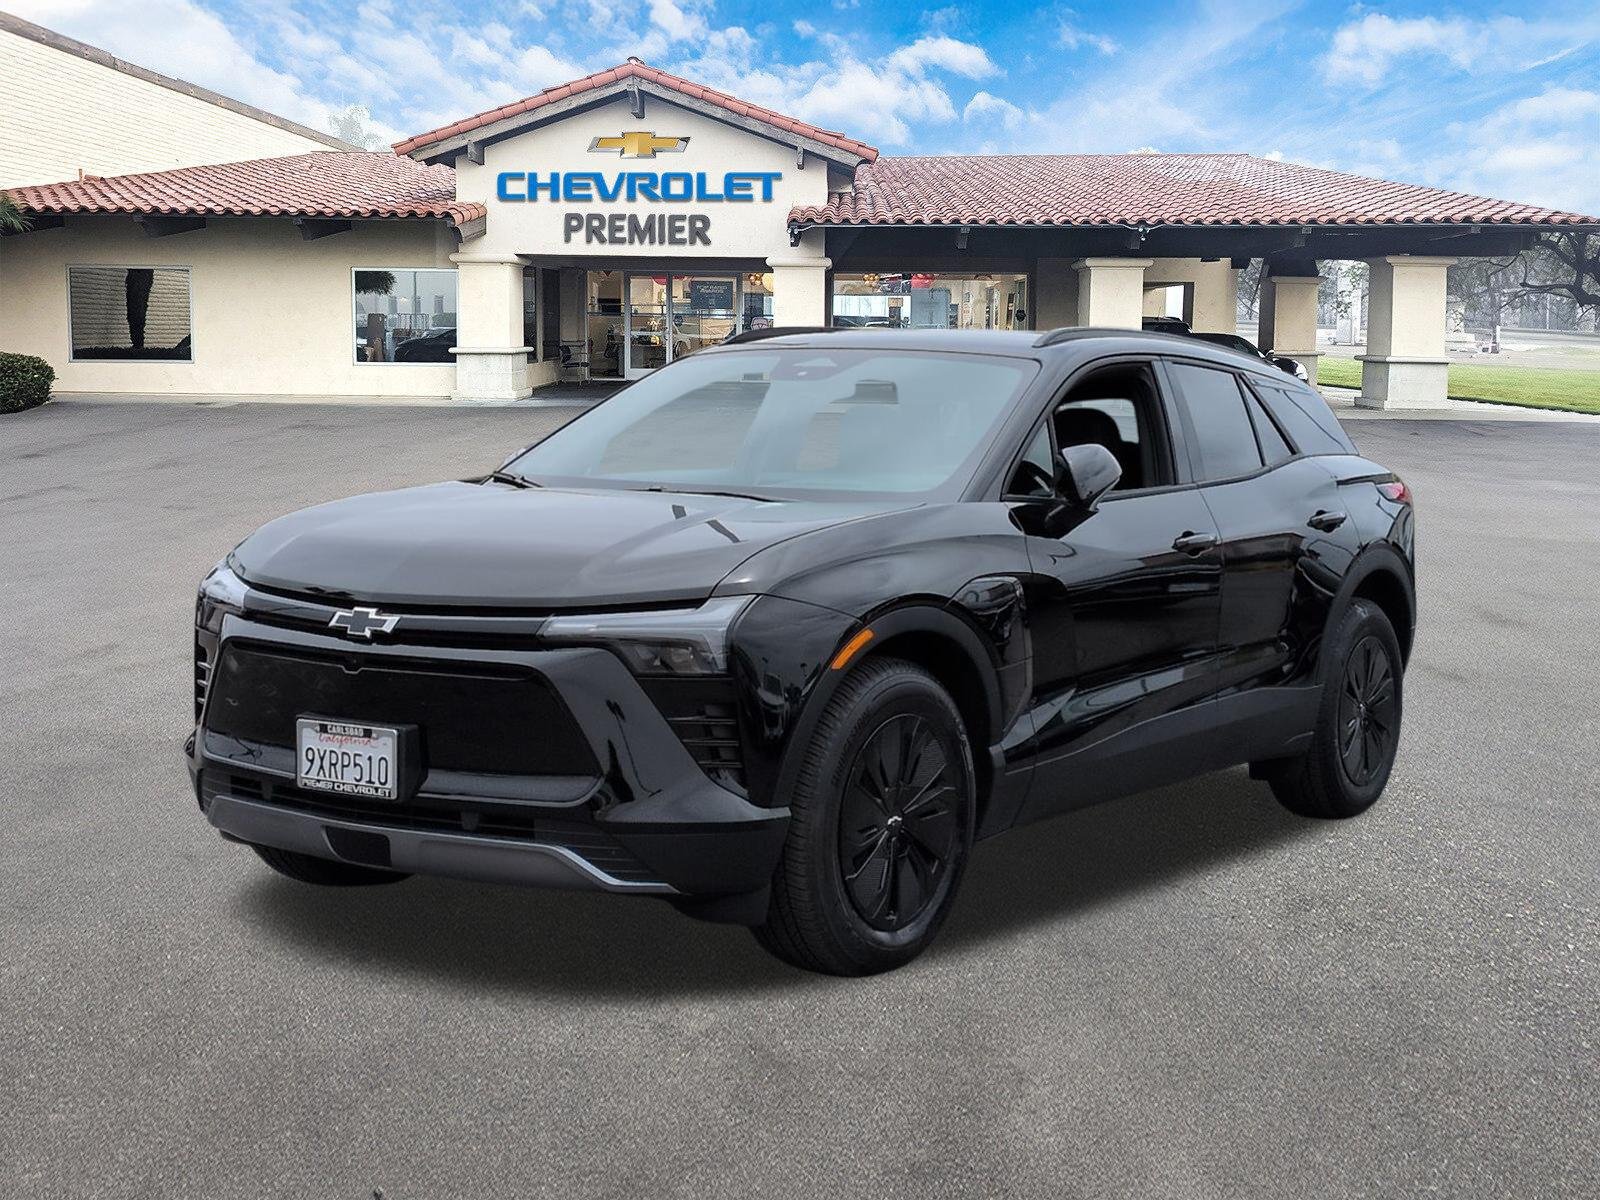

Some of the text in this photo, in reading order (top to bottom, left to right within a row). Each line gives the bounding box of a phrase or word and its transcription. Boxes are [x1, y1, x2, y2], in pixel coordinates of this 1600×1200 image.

[497, 172, 782, 202] CHEVROLET
[564, 213, 711, 245] PREMIER
[305, 747, 388, 786] 9XRP510
[302, 779, 390, 797] PREMIER CHEVROLET
